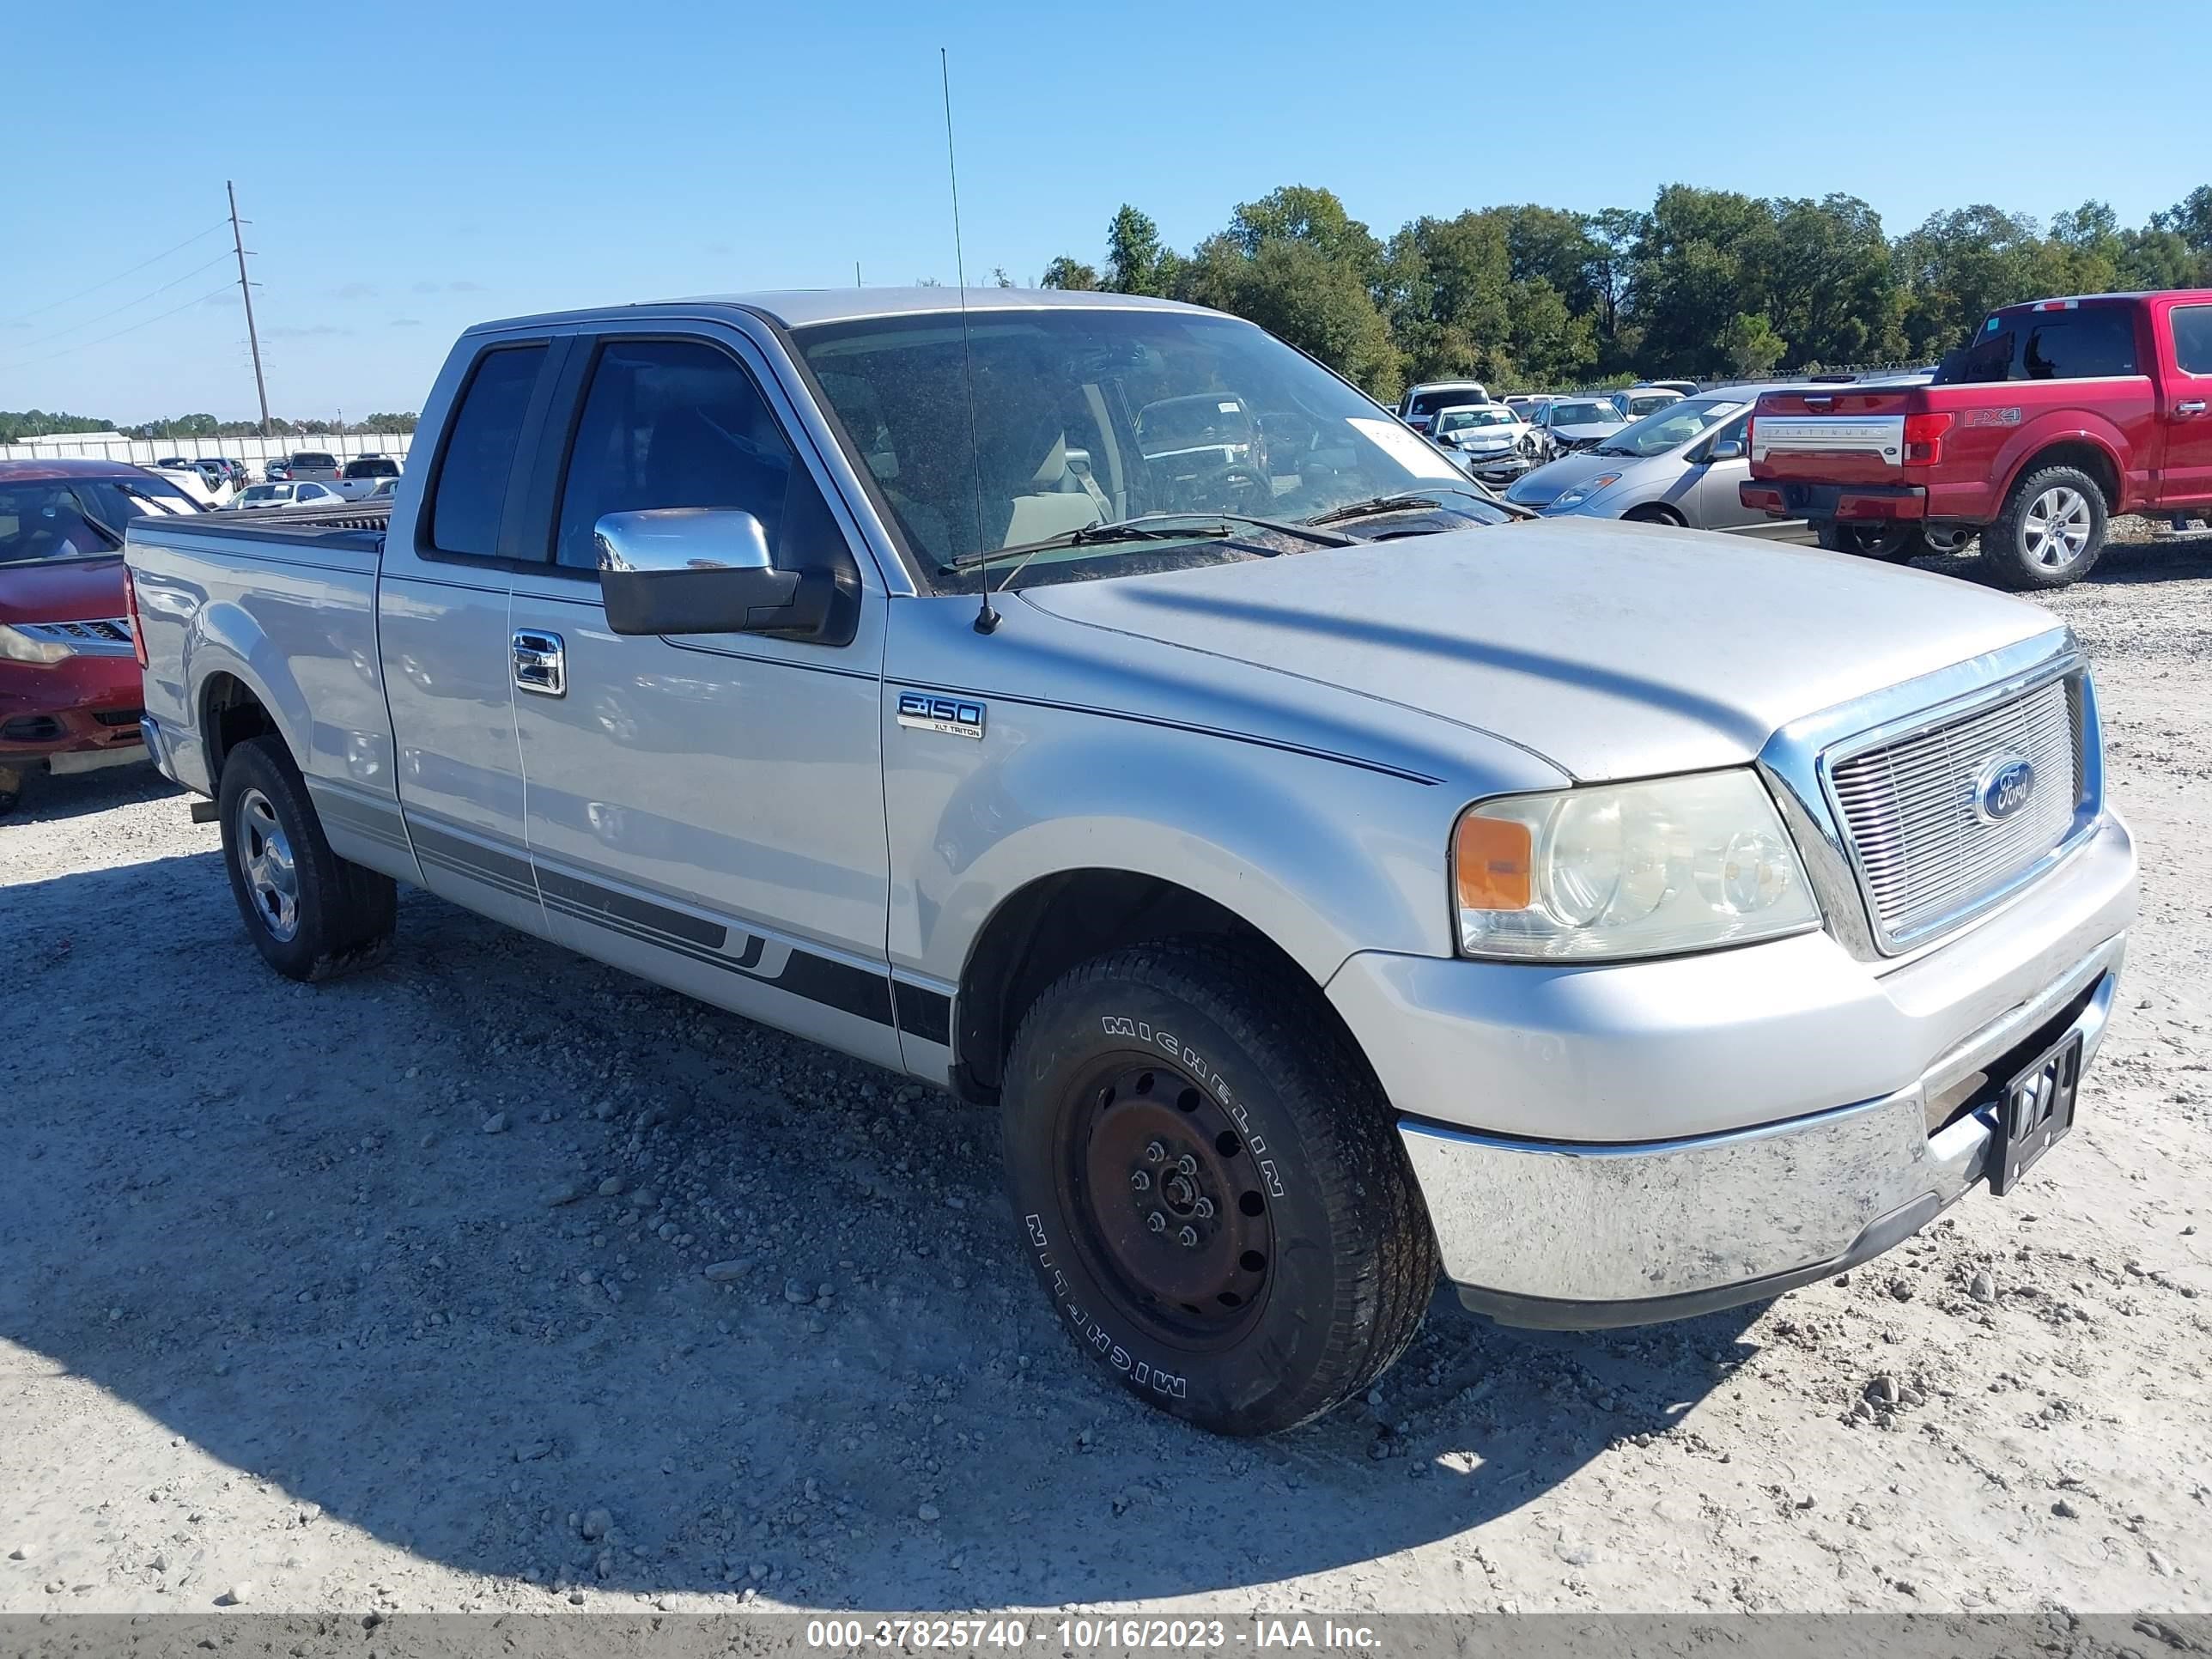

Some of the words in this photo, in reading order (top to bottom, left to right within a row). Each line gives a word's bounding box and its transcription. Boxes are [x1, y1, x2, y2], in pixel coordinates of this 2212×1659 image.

[1964, 407, 2021, 427] FX4
[898, 695, 981, 726] F-150
[933, 723, 949, 732] XLT
[949, 726, 980, 737] TRITON
[1996, 769, 2027, 811] Ford
[1101, 1015, 1285, 1198] MICHELIN
